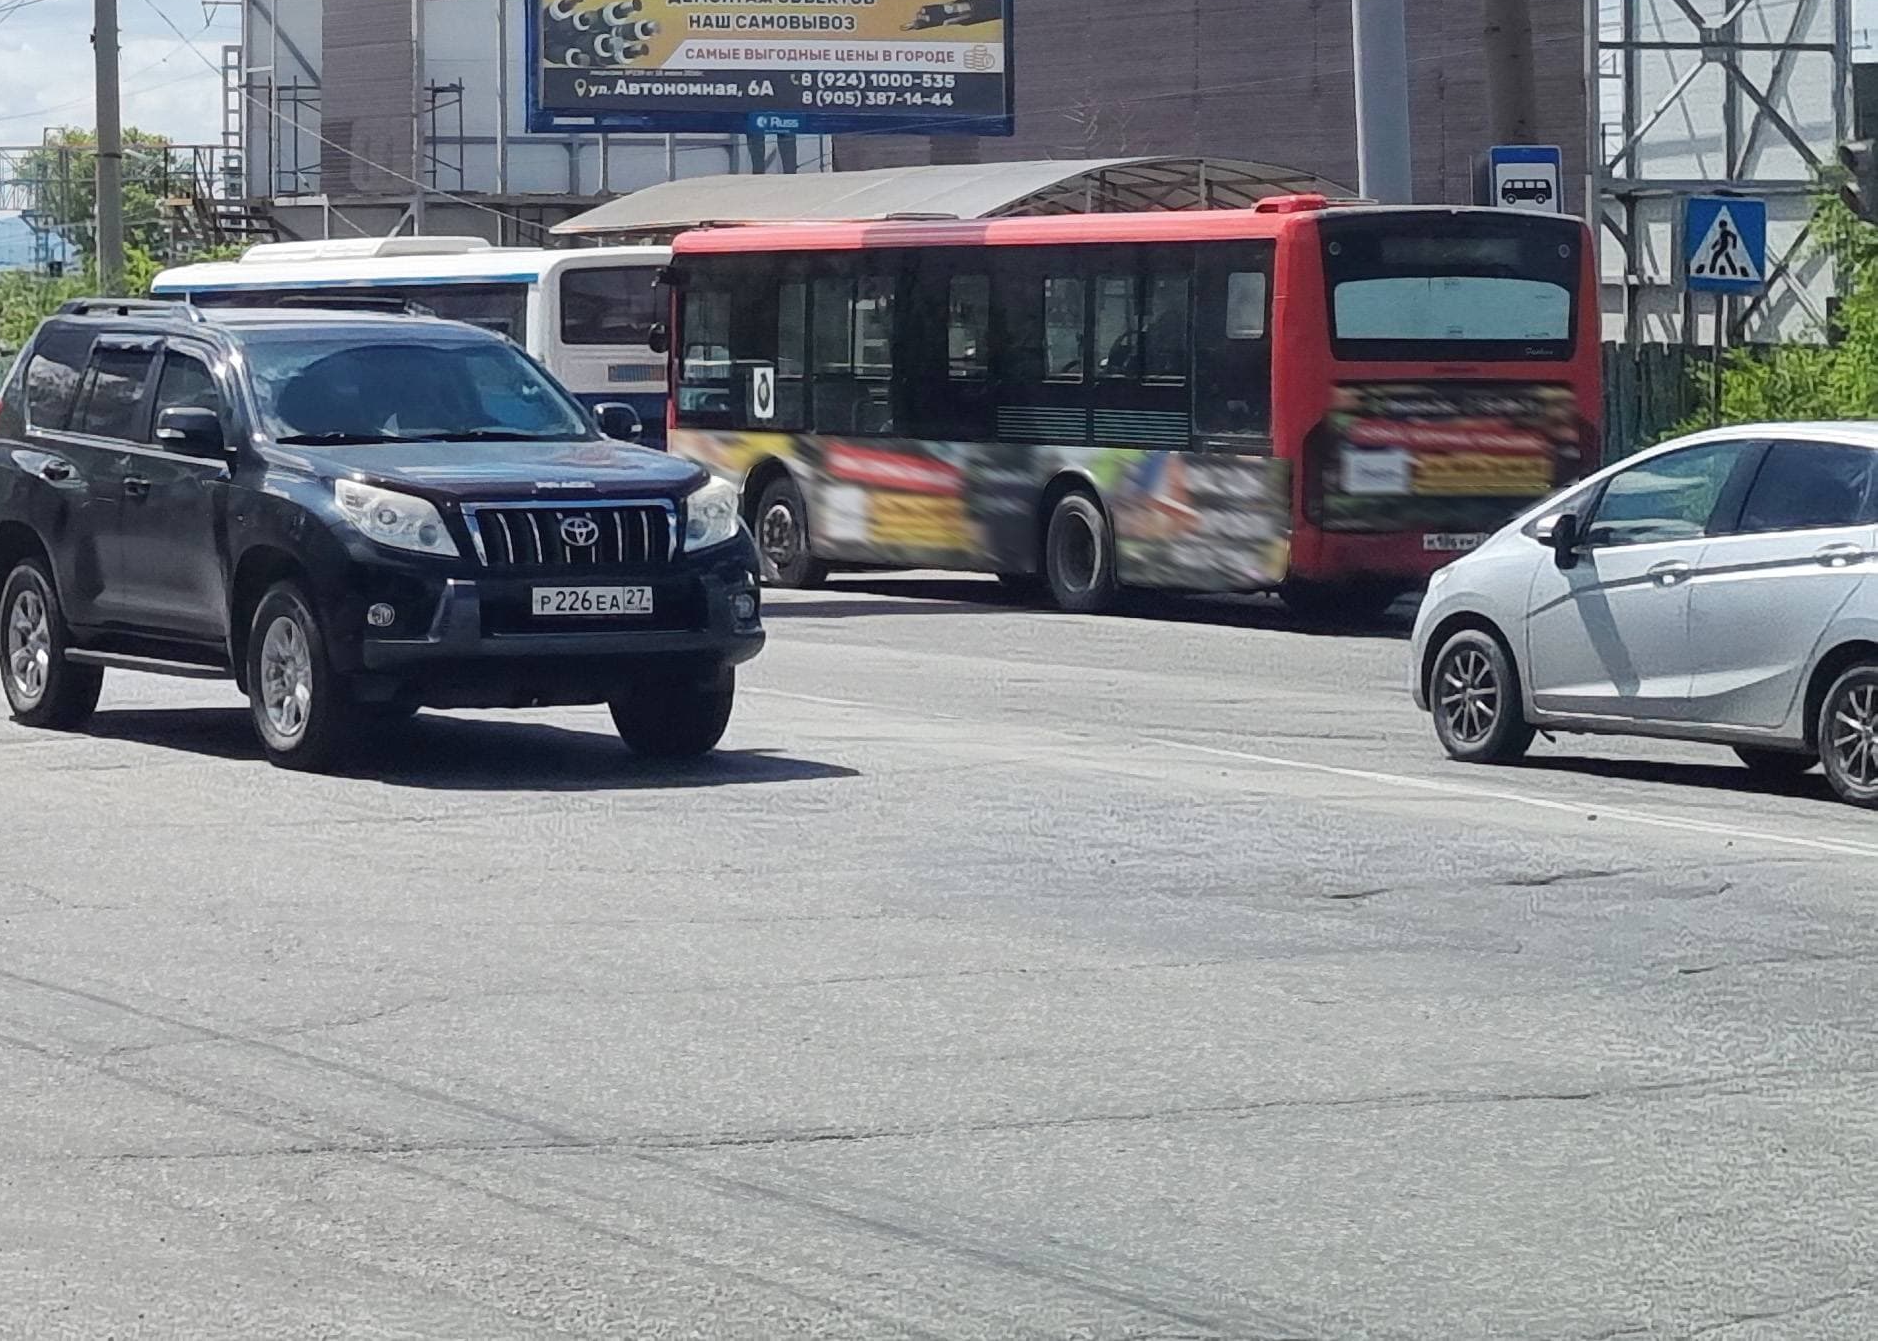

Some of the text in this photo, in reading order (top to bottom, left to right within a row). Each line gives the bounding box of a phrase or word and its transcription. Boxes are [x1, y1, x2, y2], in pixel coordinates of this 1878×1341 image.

[689, 15, 855, 30] НАШ САМОВЫВОЗ
[685, 48, 955, 63] САМЫЕ ВЫГОДНЫЕ ЦЕНЫ В ГОРОДЕ
[588, 79, 774, 97] ул. Автономная, 6А
[801, 72, 956, 89] 8 (924) 1000-535
[802, 90, 954, 107] 8 (905) 387-14-44
[626, 589, 645, 605] 27
